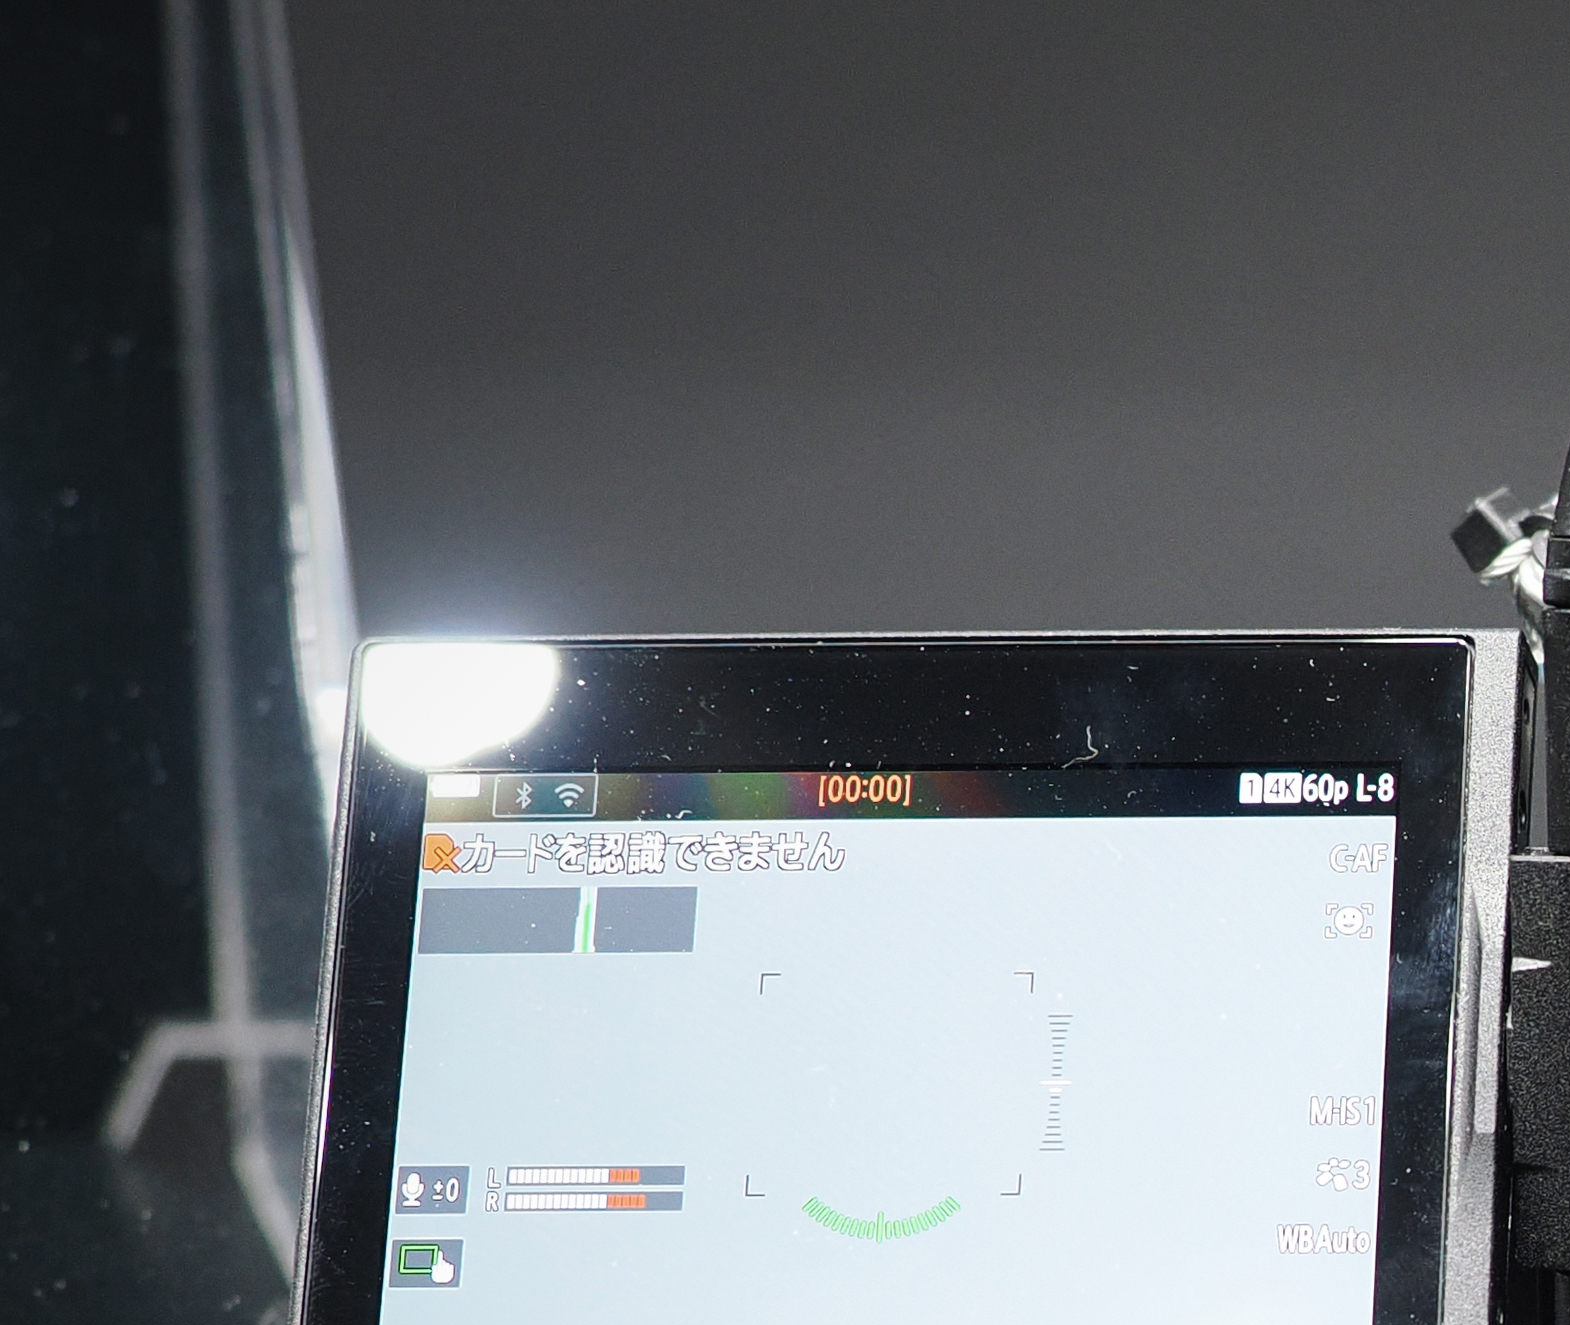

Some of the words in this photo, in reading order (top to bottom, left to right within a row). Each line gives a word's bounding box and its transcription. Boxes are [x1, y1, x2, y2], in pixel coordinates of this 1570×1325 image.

[818, 774, 913, 807] [00:00]
[1356, 772, 1395, 803] L-8
[460, 831, 847, 876] カードを認識できません
[1328, 842, 1389, 874] C-AF
[1309, 1095, 1376, 1126] M-IS1
[487, 1167, 502, 1189] L
[1352, 1158, 1371, 1190] 3
[485, 1190, 499, 1213] R
